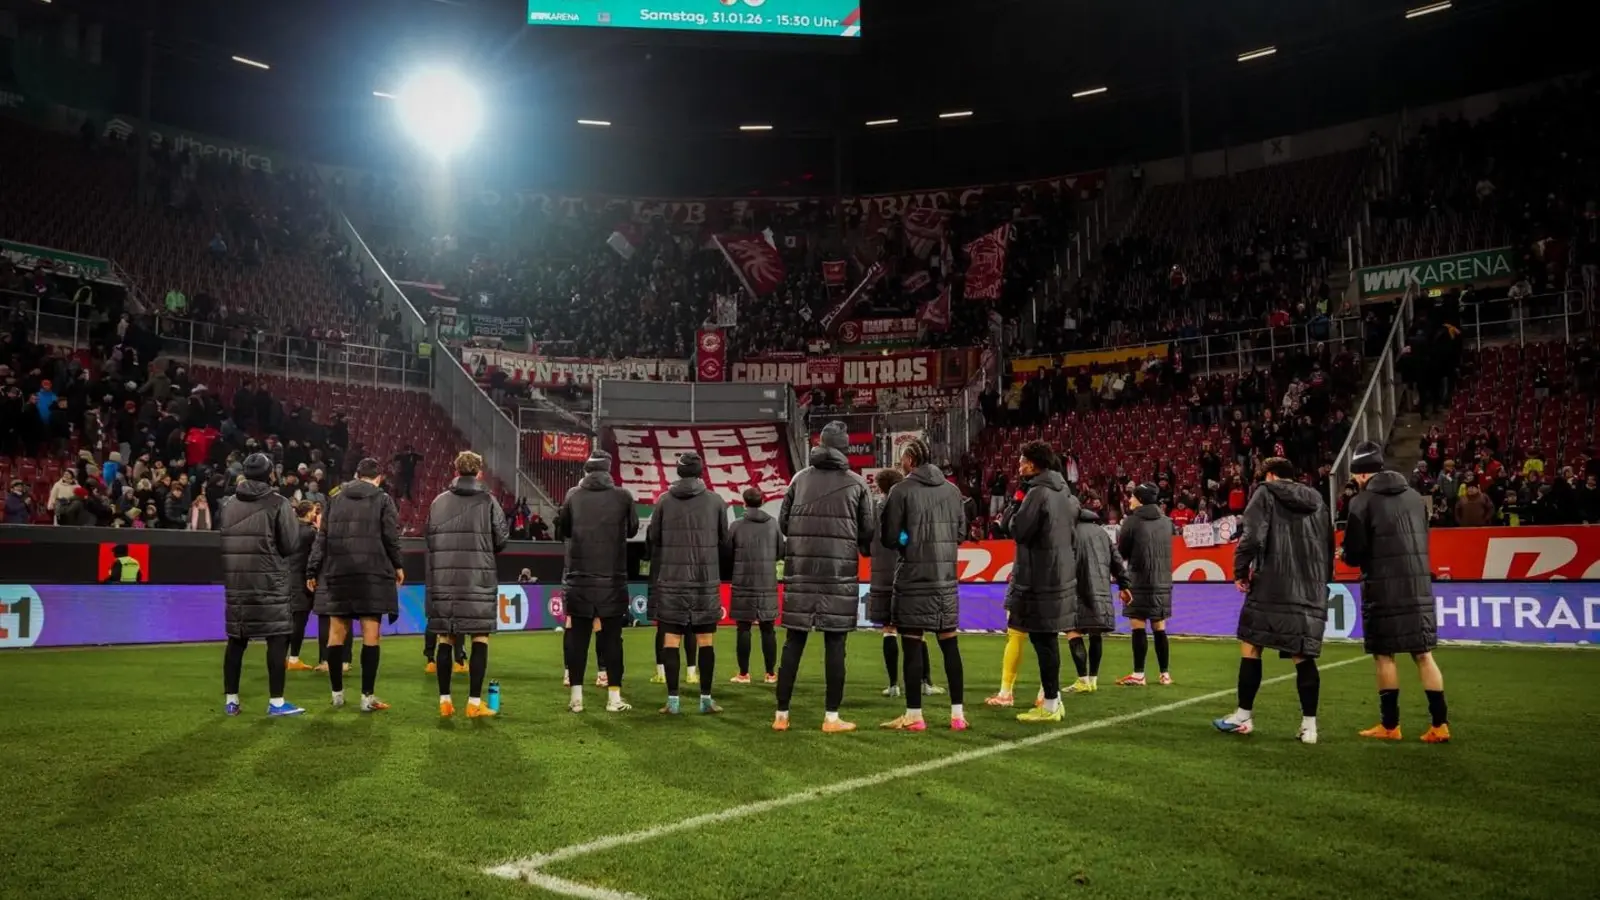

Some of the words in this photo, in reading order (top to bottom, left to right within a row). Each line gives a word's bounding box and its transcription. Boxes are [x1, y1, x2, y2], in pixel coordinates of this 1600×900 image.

[640, 9, 708, 24] Samstag,
[712, 12, 763, 24] 31.01.26
[776, 15, 810, 26] 15:30
[814, 16, 839, 27] Uhr
[1363, 253, 1511, 292] WWKARENA
[843, 356, 928, 385] ULTRAS
